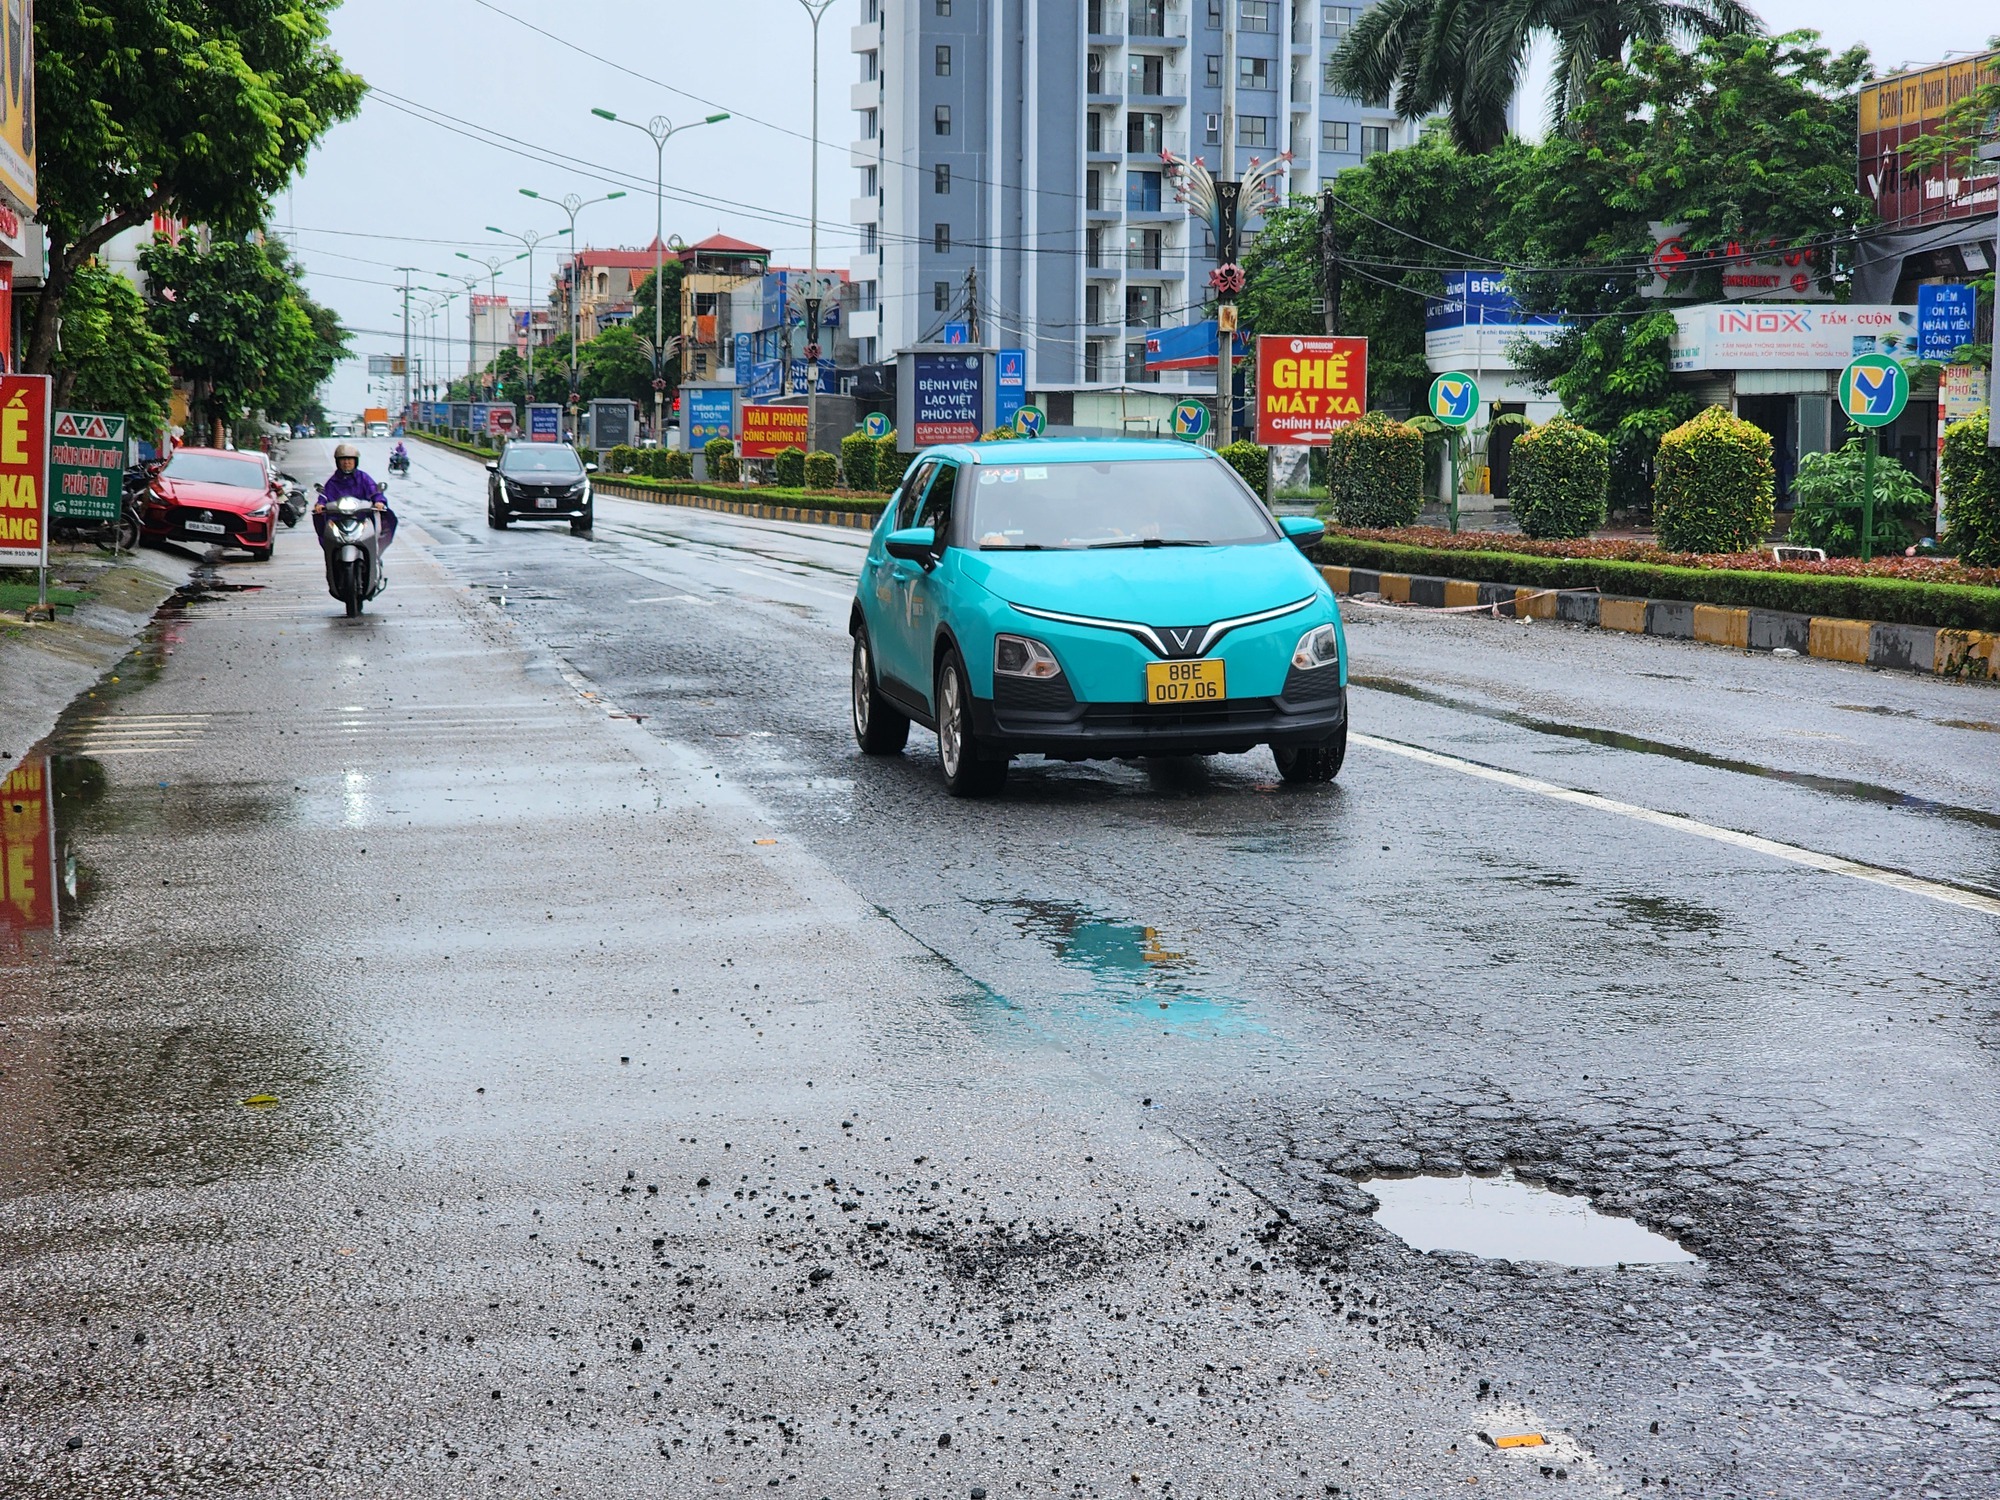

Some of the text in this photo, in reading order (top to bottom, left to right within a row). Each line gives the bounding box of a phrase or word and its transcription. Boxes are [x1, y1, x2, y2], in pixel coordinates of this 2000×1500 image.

[1906, 85, 1917, 113] TY
[1719, 312, 1805, 333] INOX
[1820, 312, 1847, 324] TẤM
[1857, 313, 1892, 327] CUỘN
[1925, 332, 1966, 345] CÔNG TY
[1272, 350, 1352, 389] GHẾ
[919, 378, 978, 393] BỆNH VIỆN
[925, 393, 973, 408] LẠC VIỆT
[1267, 391, 1361, 414] MÁT XA
[748, 409, 808, 427] VĂN PHÒNG
[921, 407, 976, 420] PHÚC YÊN
[917, 424, 974, 434] CẤP CỨU 24/24
[1272, 416, 1311, 429] CHÍNH
[744, 429, 765, 442] CÔNG
[766, 428, 793, 442] CHỨNG
[52, 441, 78, 466] PHÒNG
[78, 444, 101, 468] KHÁM
[984, 468, 1019, 476] TAXI
[62, 470, 109, 498] PHÚC YÊN
[1169, 663, 1202, 680] 88E
[1156, 682, 1217, 700] 007.06
